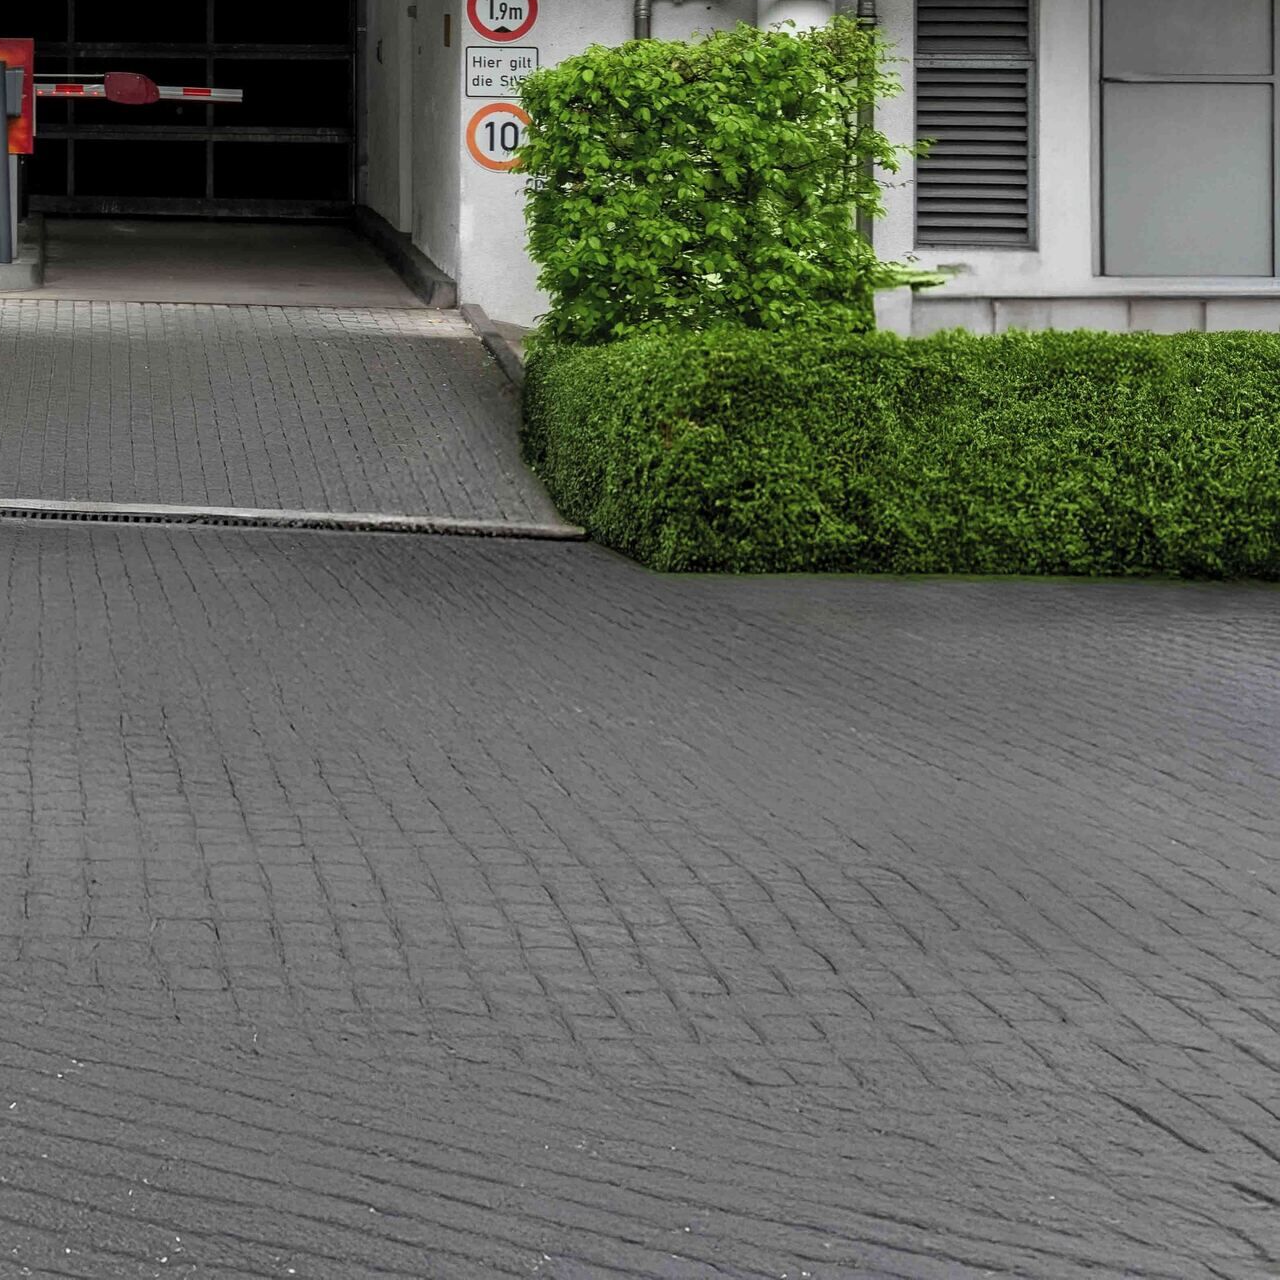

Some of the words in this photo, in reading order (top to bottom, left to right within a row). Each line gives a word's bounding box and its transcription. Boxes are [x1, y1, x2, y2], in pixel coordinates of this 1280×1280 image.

[472, 56, 502, 68] Hier
[510, 57, 532, 71] gilt
[472, 75, 493, 86] die
[485, 121, 520, 152] 10
